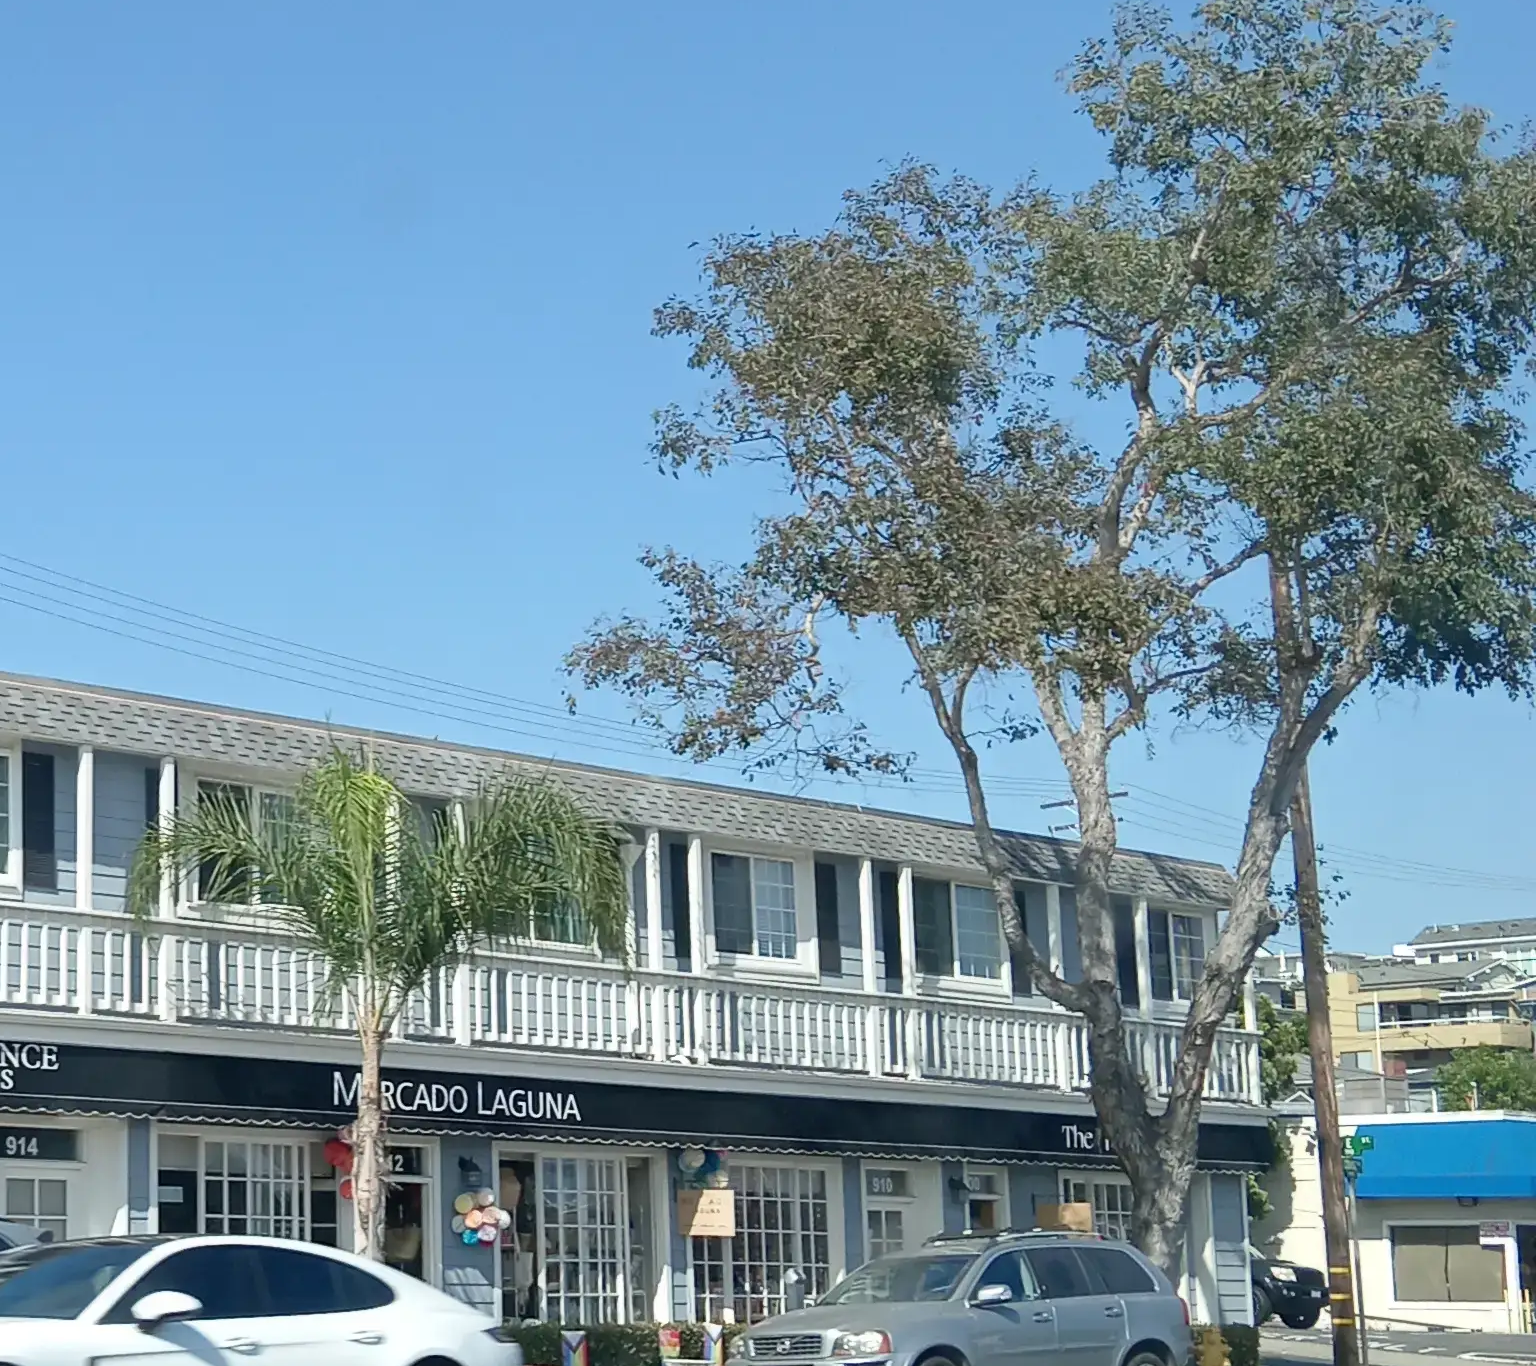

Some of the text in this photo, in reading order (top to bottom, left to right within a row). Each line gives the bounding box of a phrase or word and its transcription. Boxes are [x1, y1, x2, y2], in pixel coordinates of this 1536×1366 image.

[333, 1070, 582, 1122] MRCADO LAGUNA
[5, 1136, 40, 1157] 914
[1061, 1124, 1094, 1150] The
[387, 1154, 405, 1172] 12
[872, 1177, 893, 1193] 910
